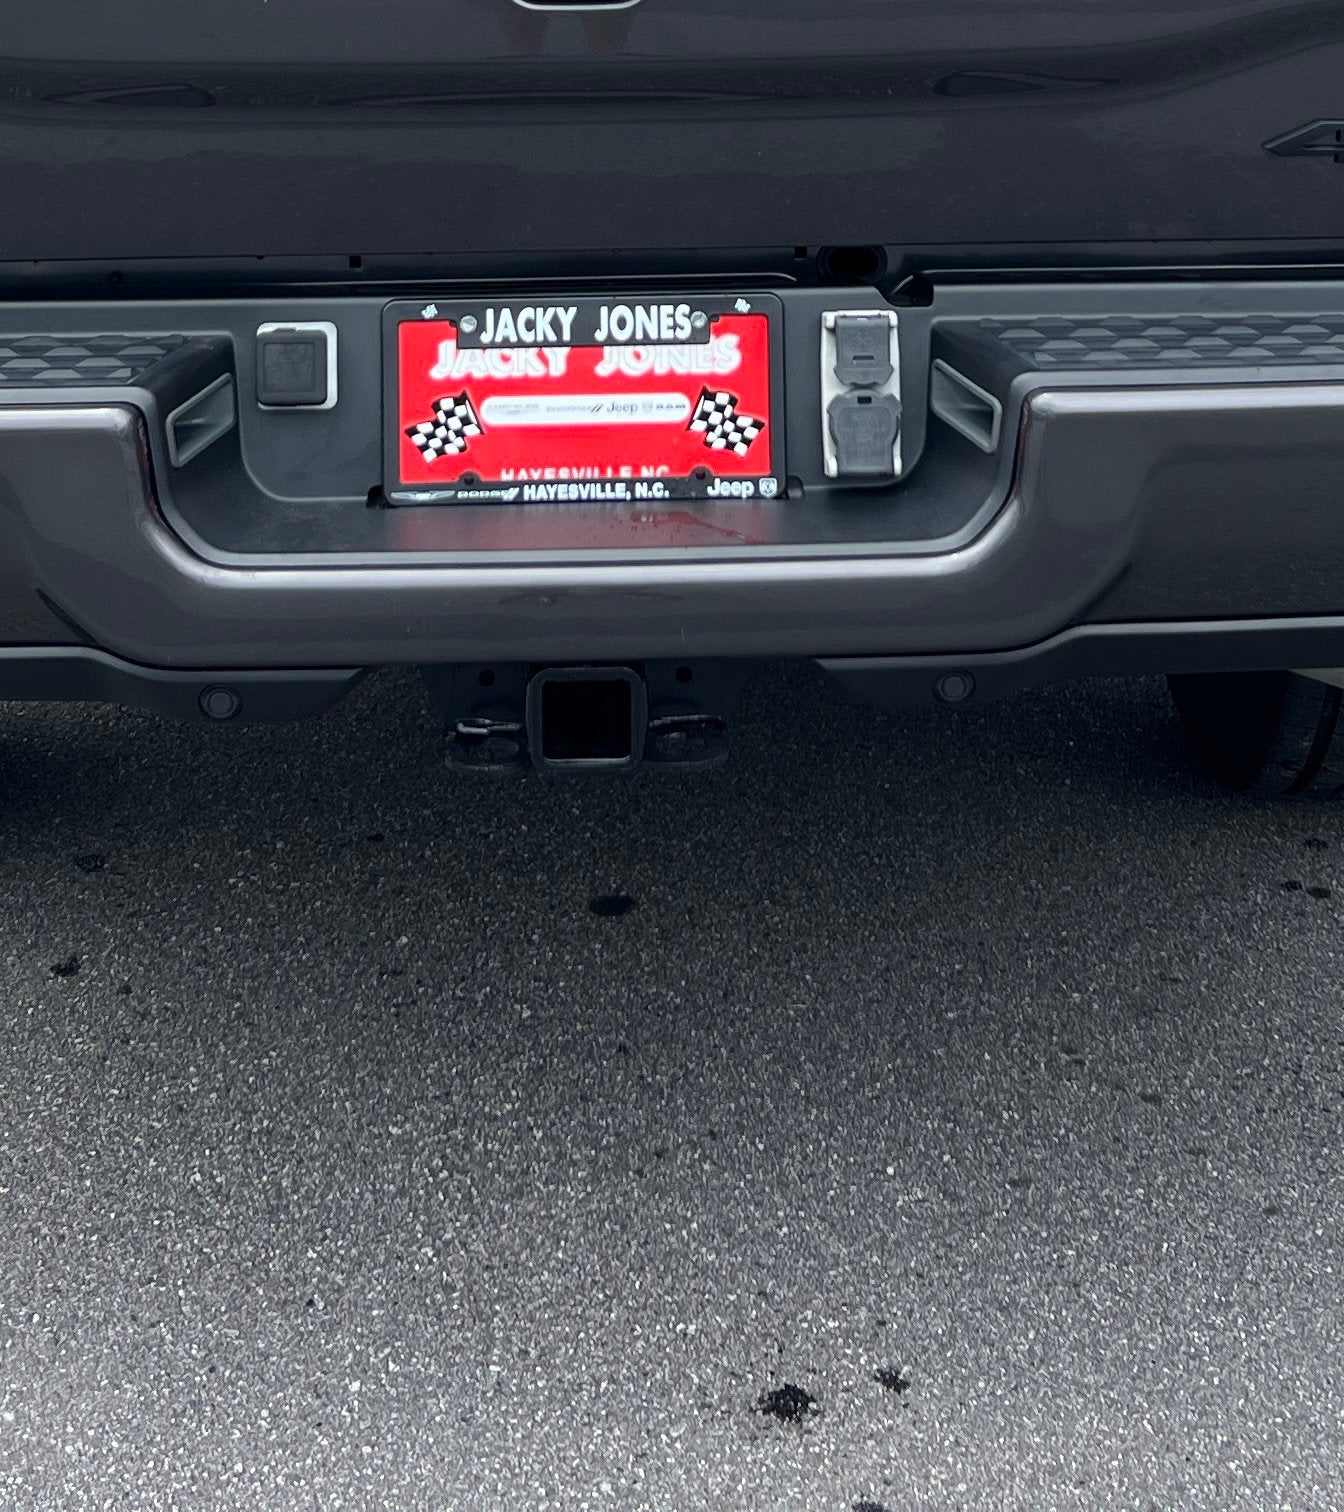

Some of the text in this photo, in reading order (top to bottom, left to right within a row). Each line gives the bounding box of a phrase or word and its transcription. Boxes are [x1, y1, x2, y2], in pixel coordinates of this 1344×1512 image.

[480, 304, 691, 343] JACKY JONES
[429, 334, 741, 379] JACKY JONES
[607, 401, 638, 415] Jeep
[523, 482, 631, 501] HAYESVILLE,
[635, 482, 670, 498] N.C.
[707, 478, 754, 498] Jeep
